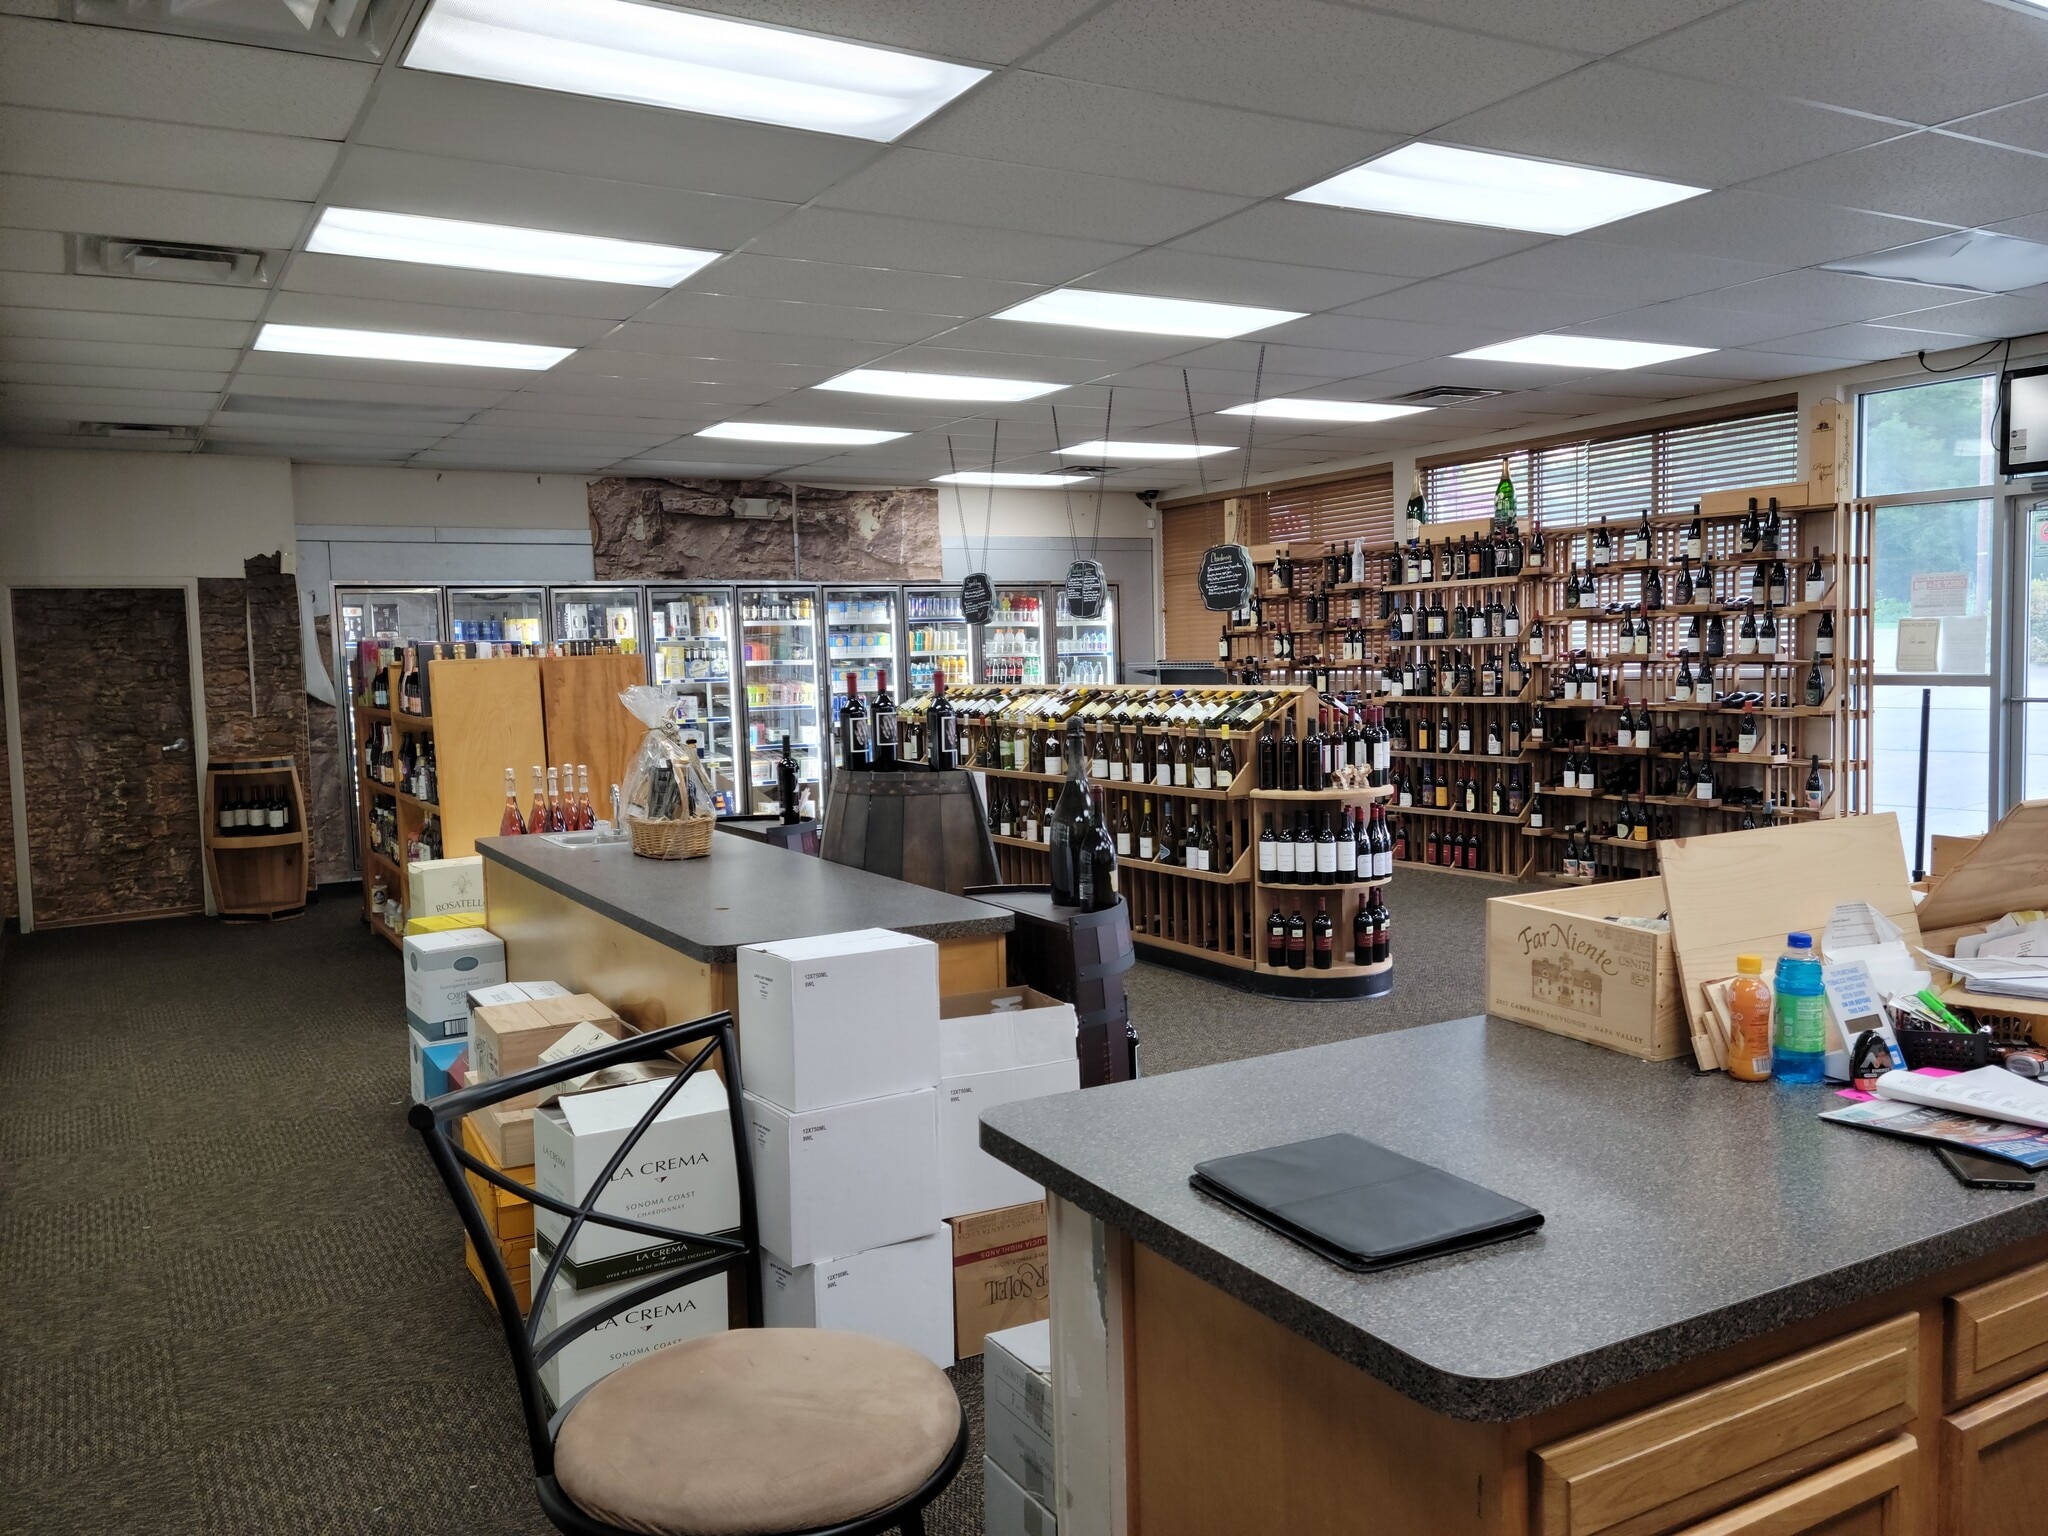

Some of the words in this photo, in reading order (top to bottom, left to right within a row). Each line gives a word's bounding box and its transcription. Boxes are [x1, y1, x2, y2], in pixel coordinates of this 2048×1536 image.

[1518, 925, 1550, 955] Far
[1550, 923, 1618, 976] Niente
[1836, 967, 1859, 976] PURCHASE
[1854, 997, 1871, 1005] BEFORE
[1510, 1002, 1544, 1016] CABERNET
[1547, 1012, 1587, 1028] SAUVIGNON
[1594, 1025, 1613, 1035] NAPA
[1616, 1031, 1643, 1044] VALLEY
[610, 1168, 634, 1182] LA
[640, 1152, 709, 1176] CREMA
[625, 1197, 664, 1211] SONOMA
[668, 1190, 696, 1202] COAST
[637, 1203, 686, 1218] CHARDONNAY
[1026, 1237, 1046, 1248] LUCIA
[636, 1253, 649, 1261] LA
[651, 1244, 688, 1258] CREMA
[980, 1244, 1023, 1259] HIGHLANDS
[1012, 1255, 1033, 1264] PINOT
[606, 1271, 620, 1279] OVER
[654, 1256, 686, 1267] WINEMAKING
[687, 1249, 716, 1259] EXCELLENCE
[985, 1272, 1033, 1305] SOLEIL
[594, 1318, 618, 1332] LA
[625, 1299, 697, 1324] CREMA
[610, 1346, 650, 1361] SONOMA
